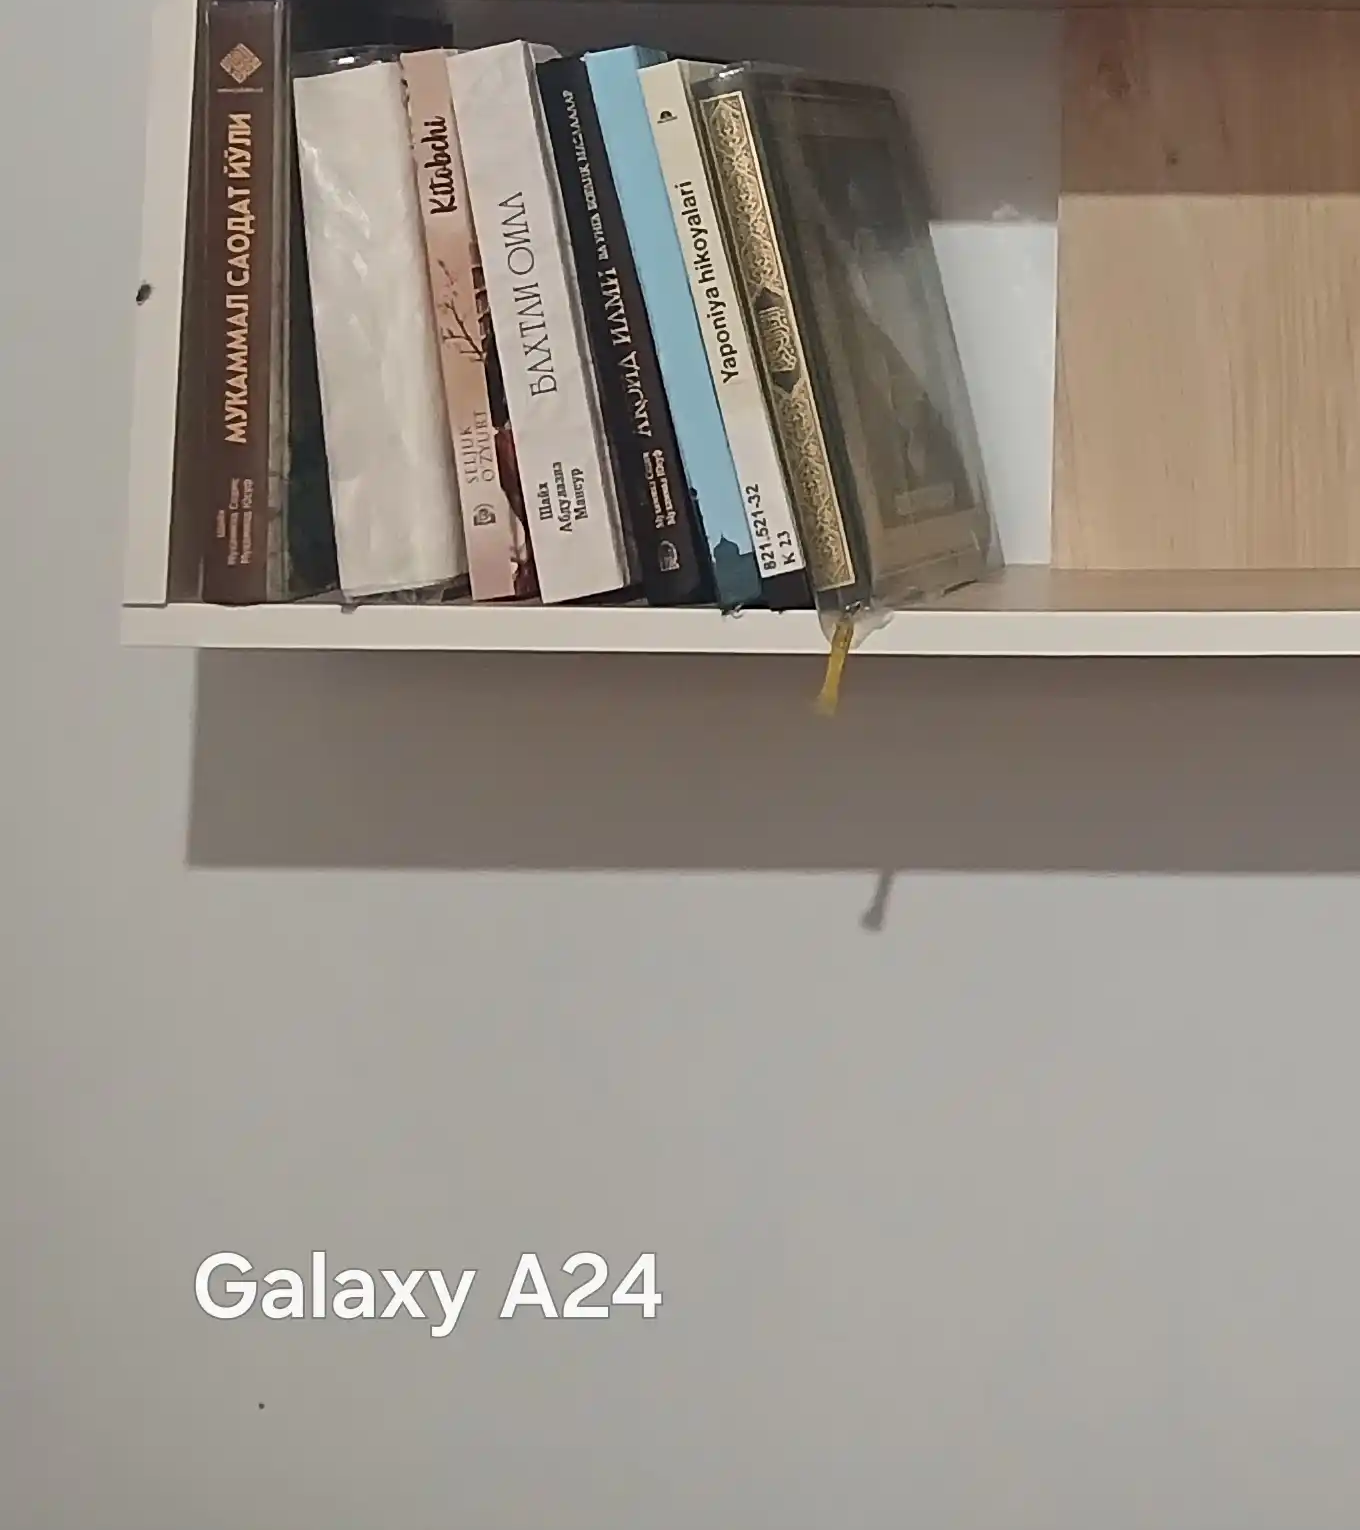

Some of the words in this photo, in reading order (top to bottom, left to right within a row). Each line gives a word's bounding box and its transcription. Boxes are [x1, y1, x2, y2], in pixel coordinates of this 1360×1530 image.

[223, 112, 252, 179] ЙЎЛИ
[420, 115, 458, 215] Kitobchi
[225, 186, 256, 288] САОДАТ
[498, 191, 535, 277] ОИЛА
[674, 180, 716, 284] hikoyalari
[224, 293, 249, 444] МУКАММАЛ
[512, 281, 558, 398] БАХТЛИ
[705, 285, 739, 384] Yaponiya
[617, 350, 652, 438] АҚОИД
[459, 424, 479, 485] SELJUK
[571, 467, 589, 521] Мансур
[537, 482, 554, 521] Шайх
[745, 483, 777, 571] 821.521-32
[779, 529, 792, 551] 23
